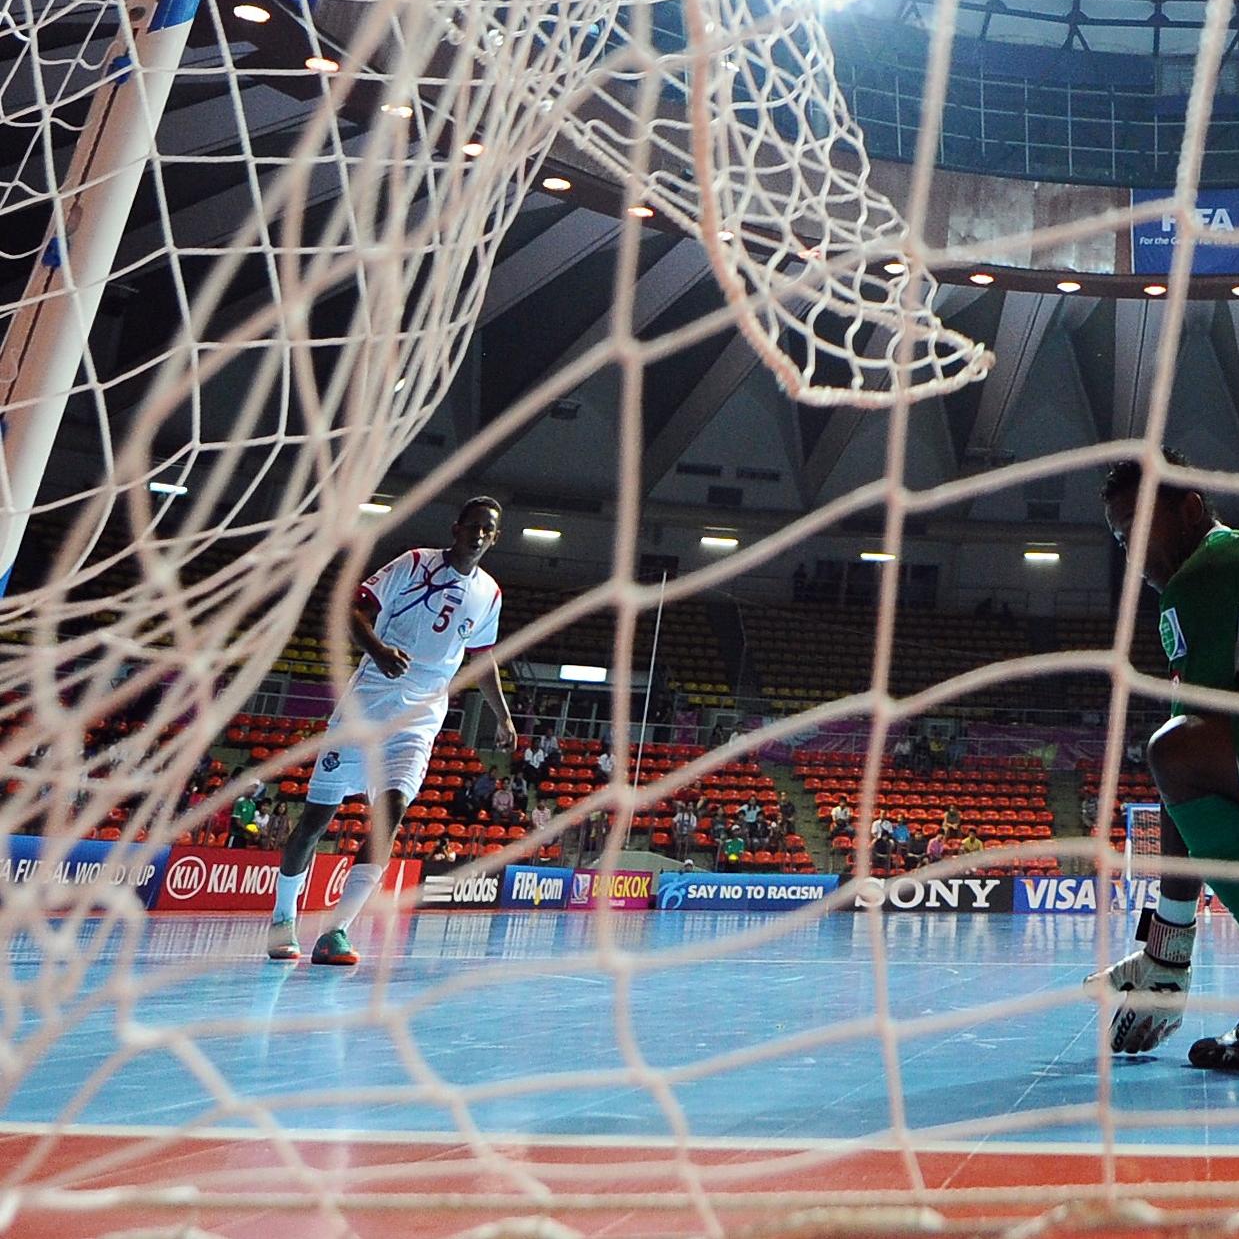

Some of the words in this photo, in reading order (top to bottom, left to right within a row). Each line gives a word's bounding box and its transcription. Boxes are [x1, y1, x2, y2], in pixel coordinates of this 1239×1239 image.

[1161, 208, 1234, 232] FFA
[432, 604, 455, 634] 5
[14, 859, 71, 885] FUAL
[206, 864, 240, 895] KIA
[453, 871, 498, 903] adidas
[592, 874, 651, 898] BNGKOK
[687, 884, 718, 899] SAY
[719, 885, 743, 899] NO
[746, 885, 764, 899] TO
[767, 885, 824, 900] RACISM
[853, 876, 1001, 909] SONY
[1020, 878, 1098, 910] VISA
[1112, 878, 1161, 910] VIS
